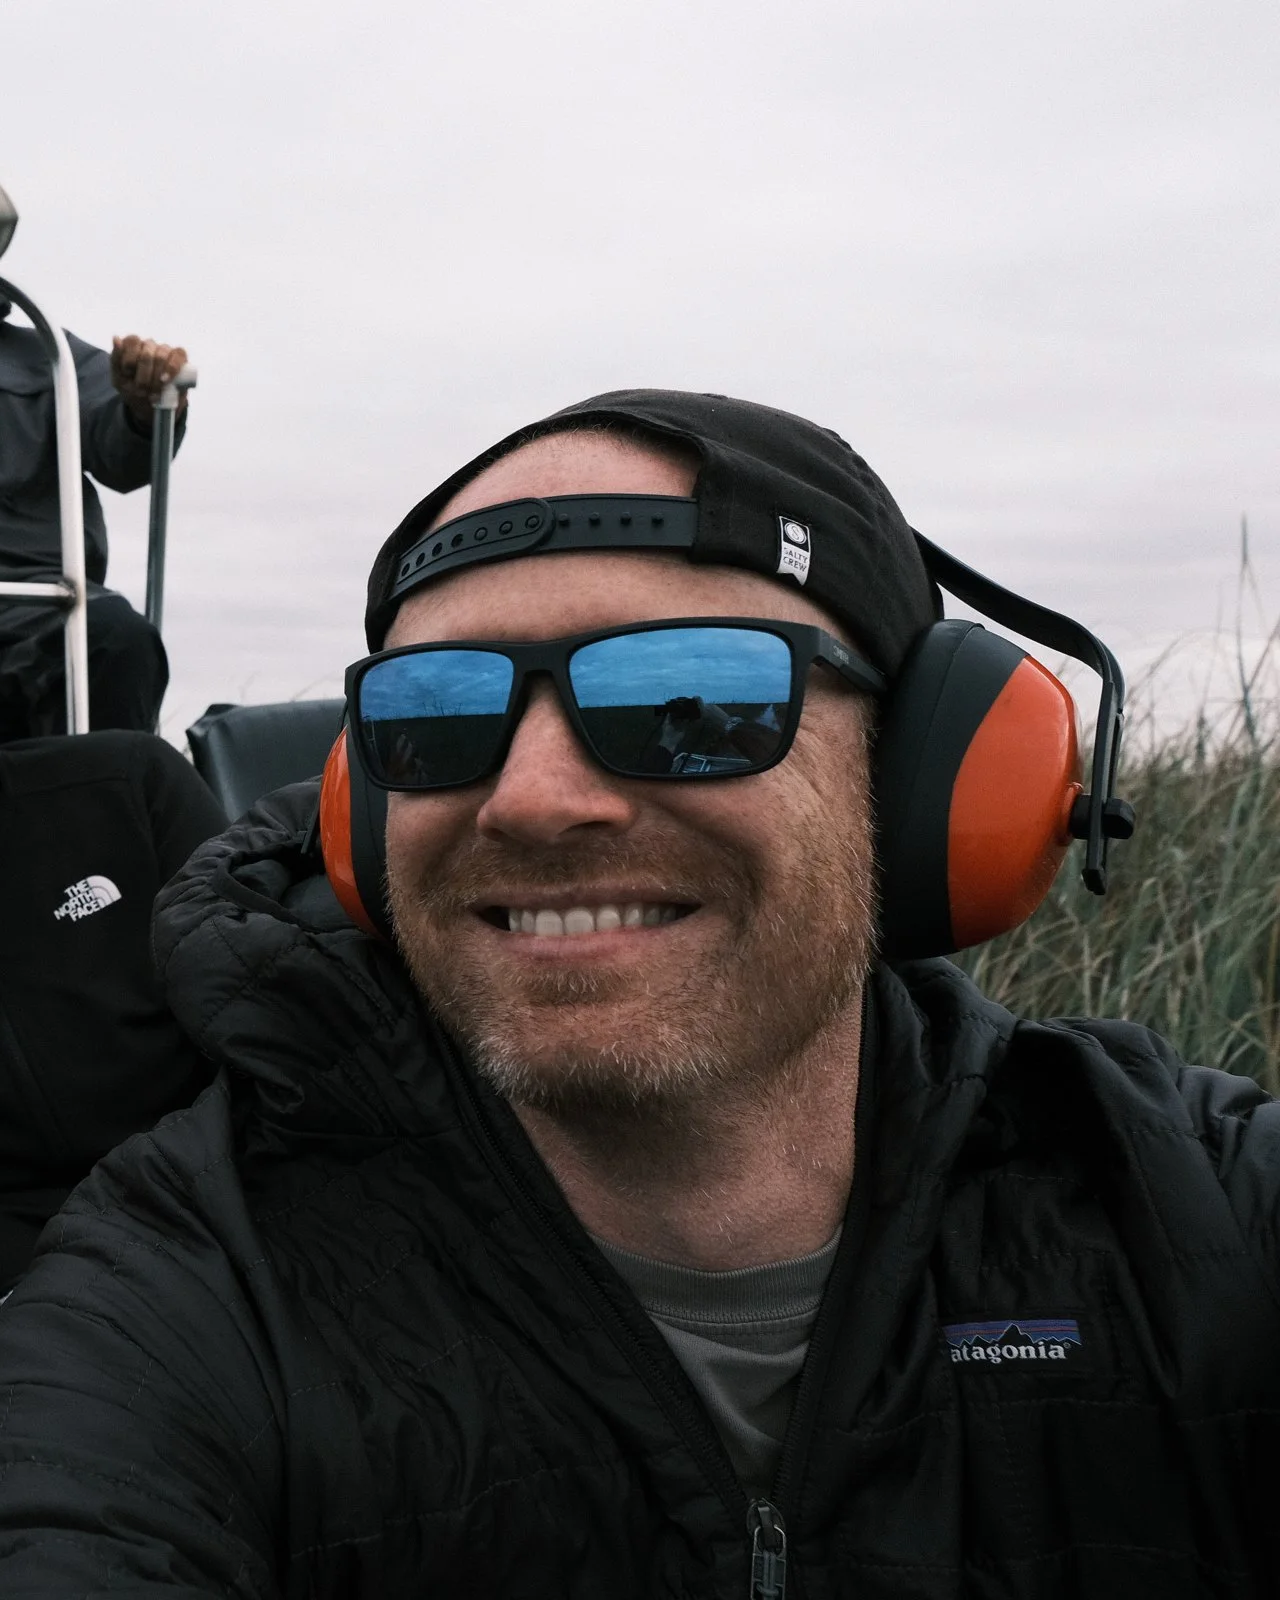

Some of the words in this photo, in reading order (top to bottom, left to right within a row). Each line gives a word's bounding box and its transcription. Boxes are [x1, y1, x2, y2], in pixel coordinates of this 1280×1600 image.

[783, 547, 808, 564] SALTY
[783, 557, 807, 572] CREW
[64, 878, 91, 898] THE
[53, 890, 96, 922] NORTH
[69, 899, 101, 922] FACE
[950, 1341, 1067, 1364] atagonia
